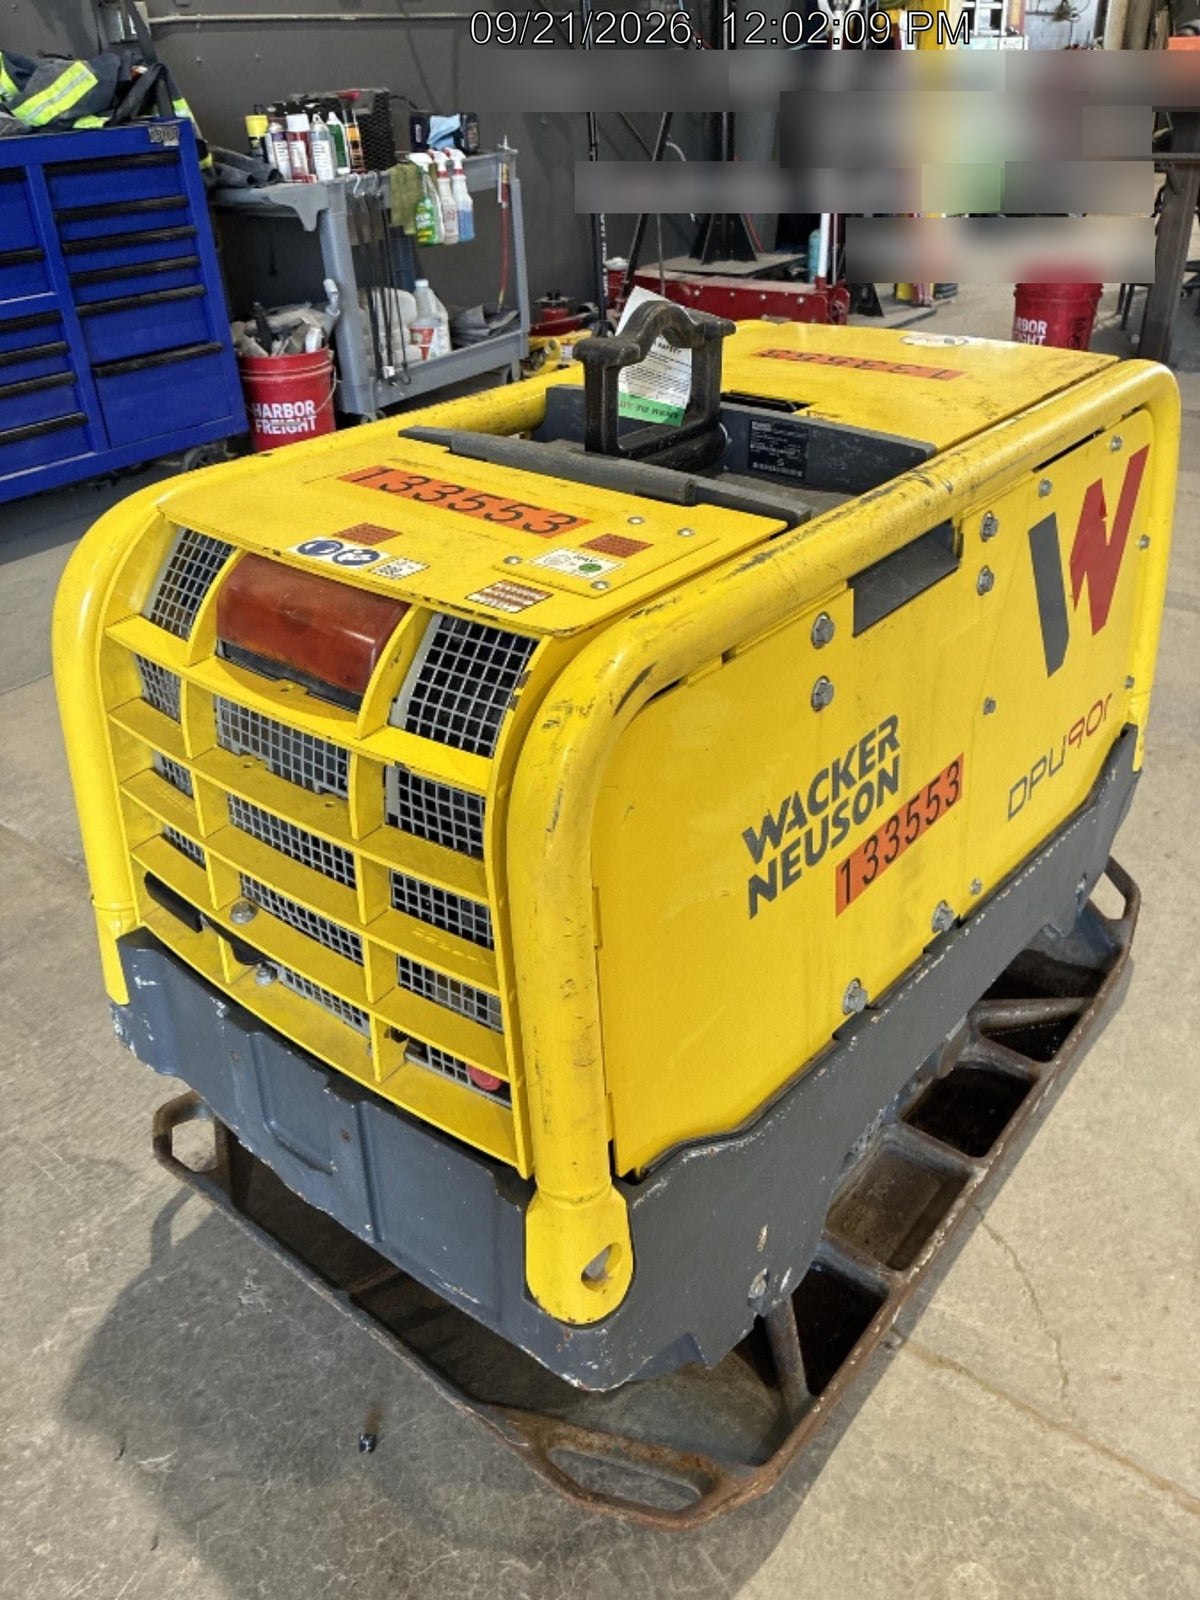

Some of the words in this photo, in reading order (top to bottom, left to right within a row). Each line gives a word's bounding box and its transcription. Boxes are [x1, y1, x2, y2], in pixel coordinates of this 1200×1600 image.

[253, 400, 315, 418] HARBOR
[255, 415, 317, 435] FREIGHT
[351, 467, 578, 534] 133553
[740, 714, 901, 865] WACKER
[748, 753, 900, 920] NEUSON
[840, 760, 960, 905] 133553
